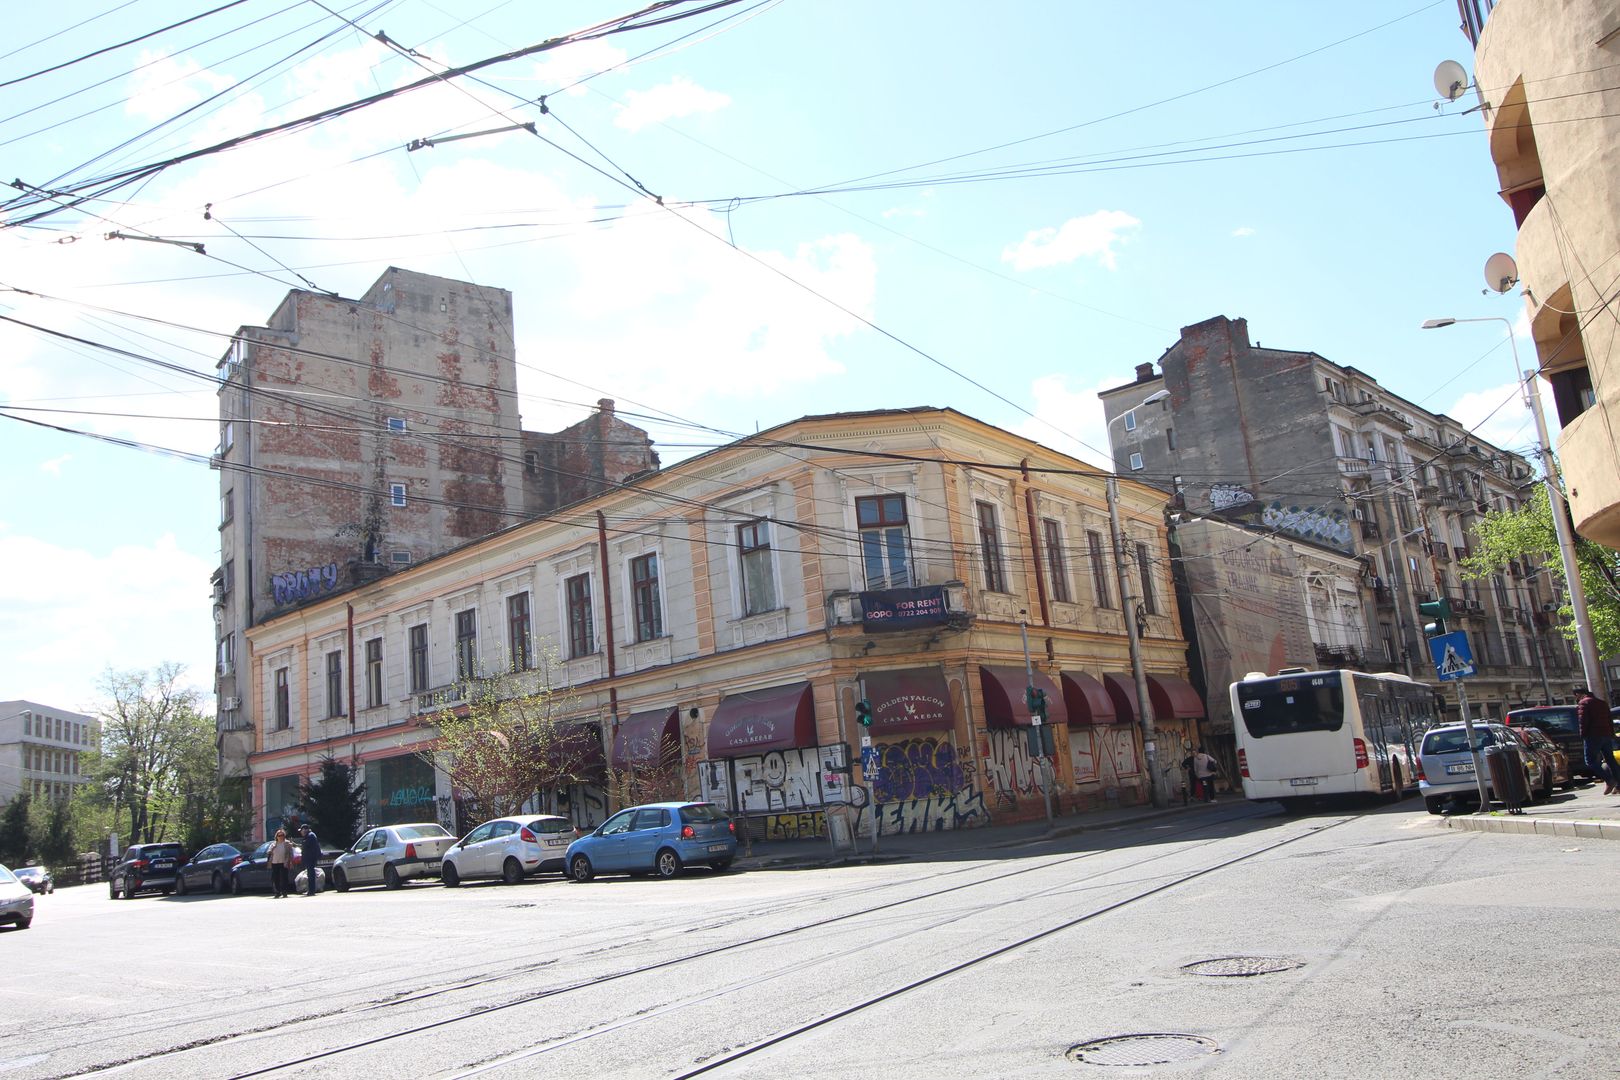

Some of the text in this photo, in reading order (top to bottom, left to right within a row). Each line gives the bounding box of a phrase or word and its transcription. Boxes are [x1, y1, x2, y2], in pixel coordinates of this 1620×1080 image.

[896, 598, 940, 611] FOR RENT
[877, 695, 945, 713] GOLDEN FALCON
[884, 715, 908, 723] CASA
[730, 737, 749, 745] CASA
